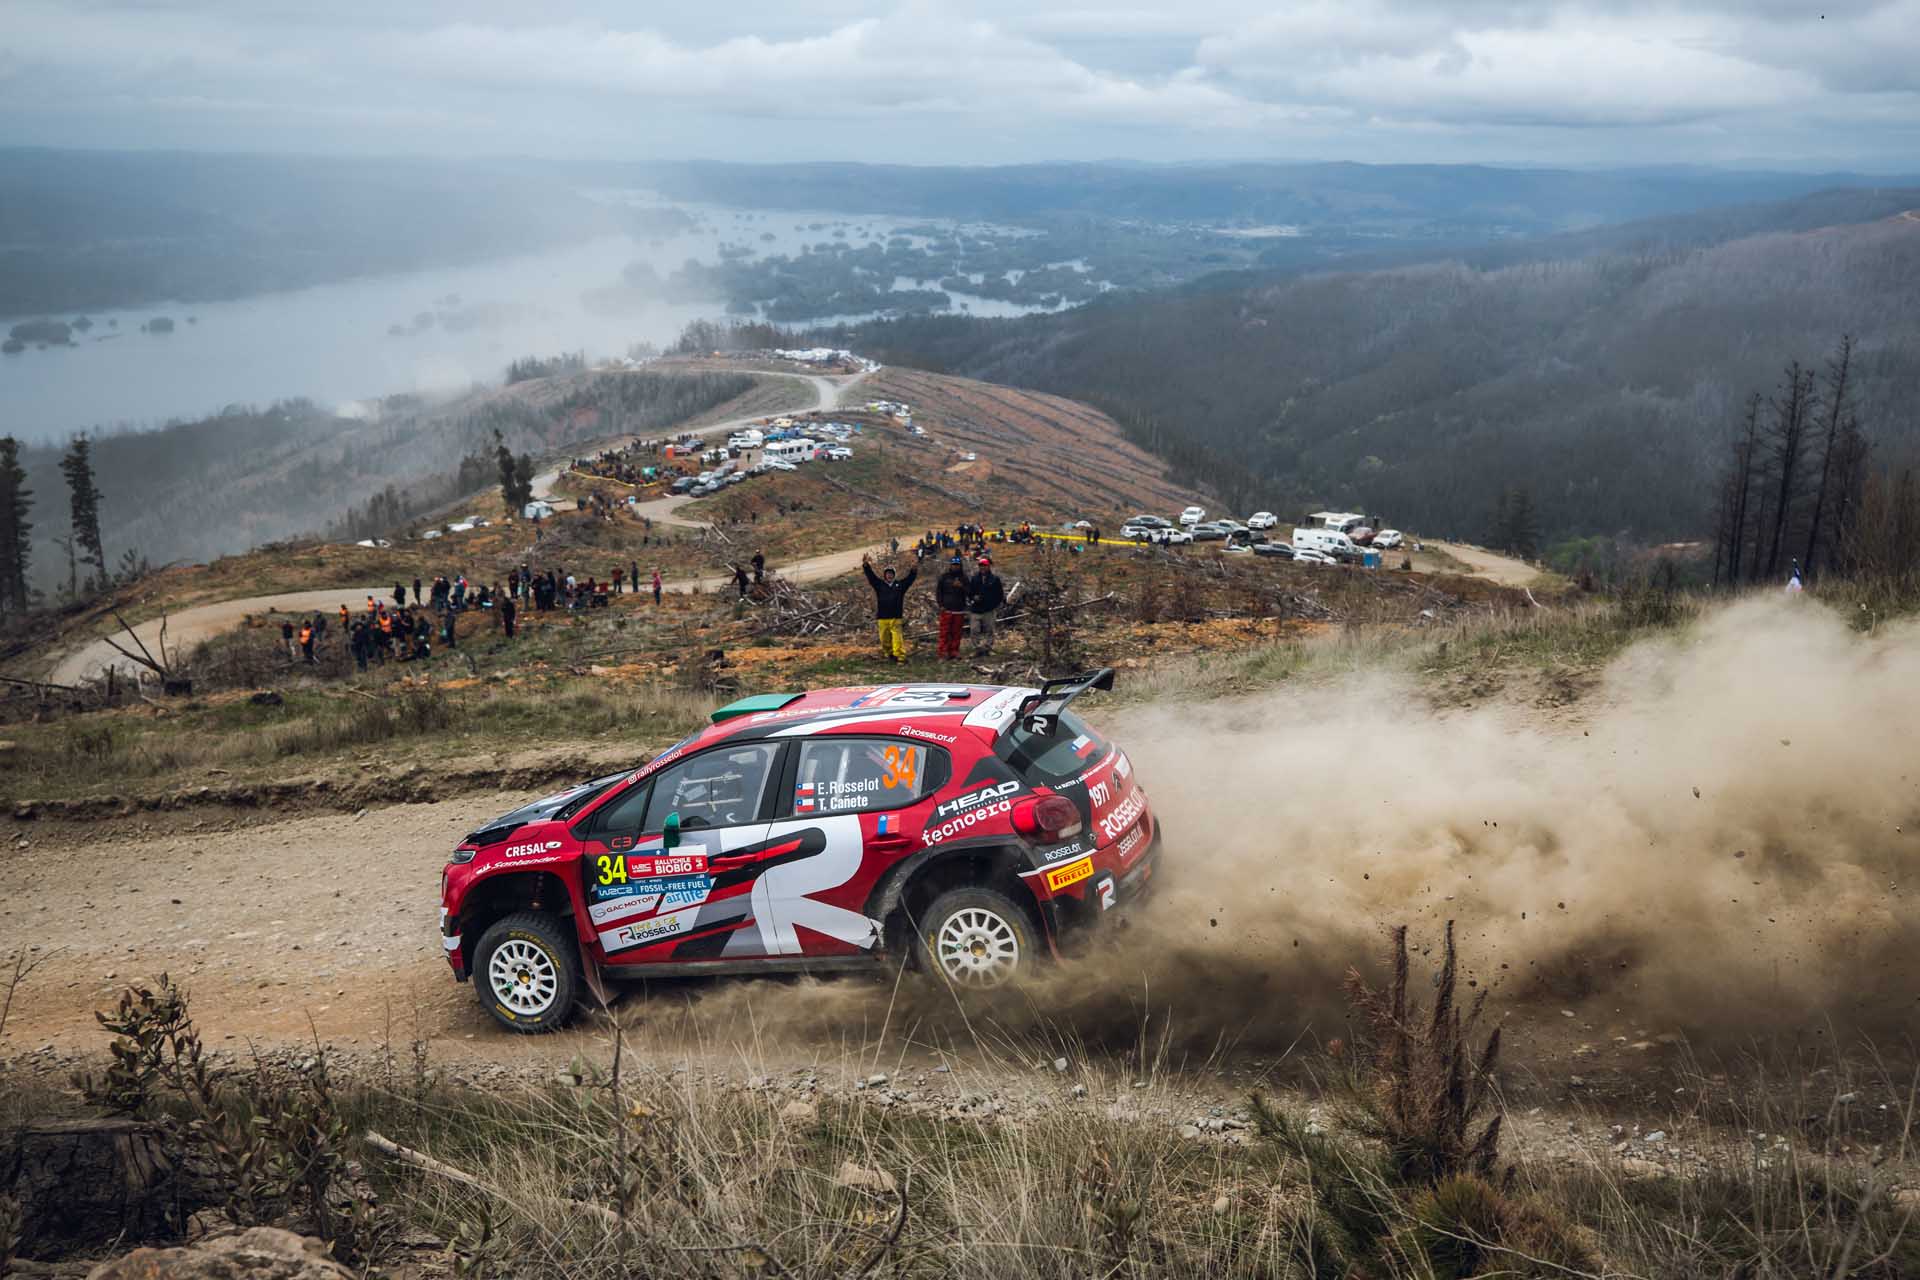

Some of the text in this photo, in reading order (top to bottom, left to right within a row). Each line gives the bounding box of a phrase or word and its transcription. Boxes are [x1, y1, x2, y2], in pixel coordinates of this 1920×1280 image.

[882, 745, 916, 789] 34
[830, 778, 879, 794] Rosselot
[1089, 781, 1110, 808] 1971
[938, 780, 1020, 817] HEAD
[922, 800, 1011, 847] tecnoera
[505, 843, 546, 858] CRESAL
[611, 837, 632, 848] C3
[1044, 842, 1081, 861] ROSSELOT
[597, 855, 627, 885] 34
[1053, 861, 1091, 886] PIRELLI
[599, 886, 633, 896] WRC2
[640, 881, 686, 893] FOSSIL-FREE
[688, 879, 707, 890] FUEL
[606, 896, 655, 914] GAC MOTOR
[636, 923, 680, 941] ROSSELOT
